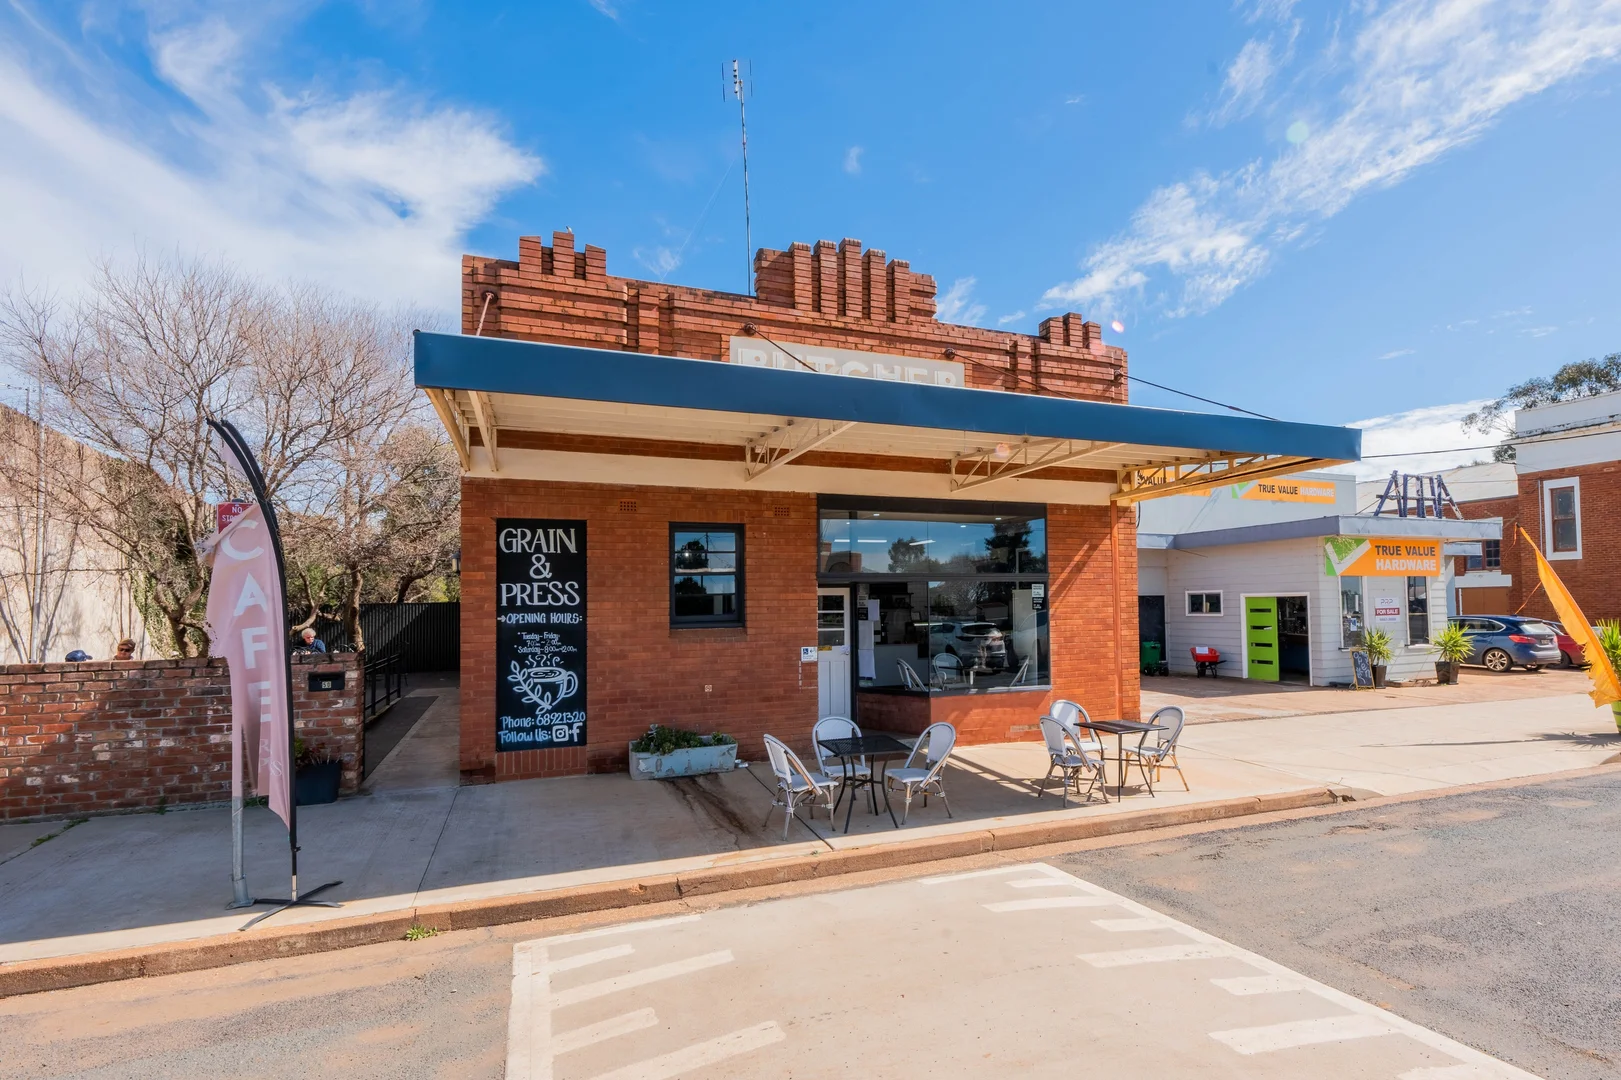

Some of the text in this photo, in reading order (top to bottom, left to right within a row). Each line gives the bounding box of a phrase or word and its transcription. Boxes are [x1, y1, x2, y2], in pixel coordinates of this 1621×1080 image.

[1258, 484, 1335, 497] TRUE VALUE HARDWARE
[499, 528, 578, 553] GRAIN
[1375, 545, 1436, 557] TRUE VALUE
[529, 554, 553, 579] &
[1376, 559, 1437, 571] HARDWARE
[500, 581, 580, 606] PRESS
[506, 613, 583, 624] OPENING HOURS:
[500, 711, 586, 731] Phone: 68921320
[498, 731, 533, 744] Follow
[535, 728, 551, 742] Us:
